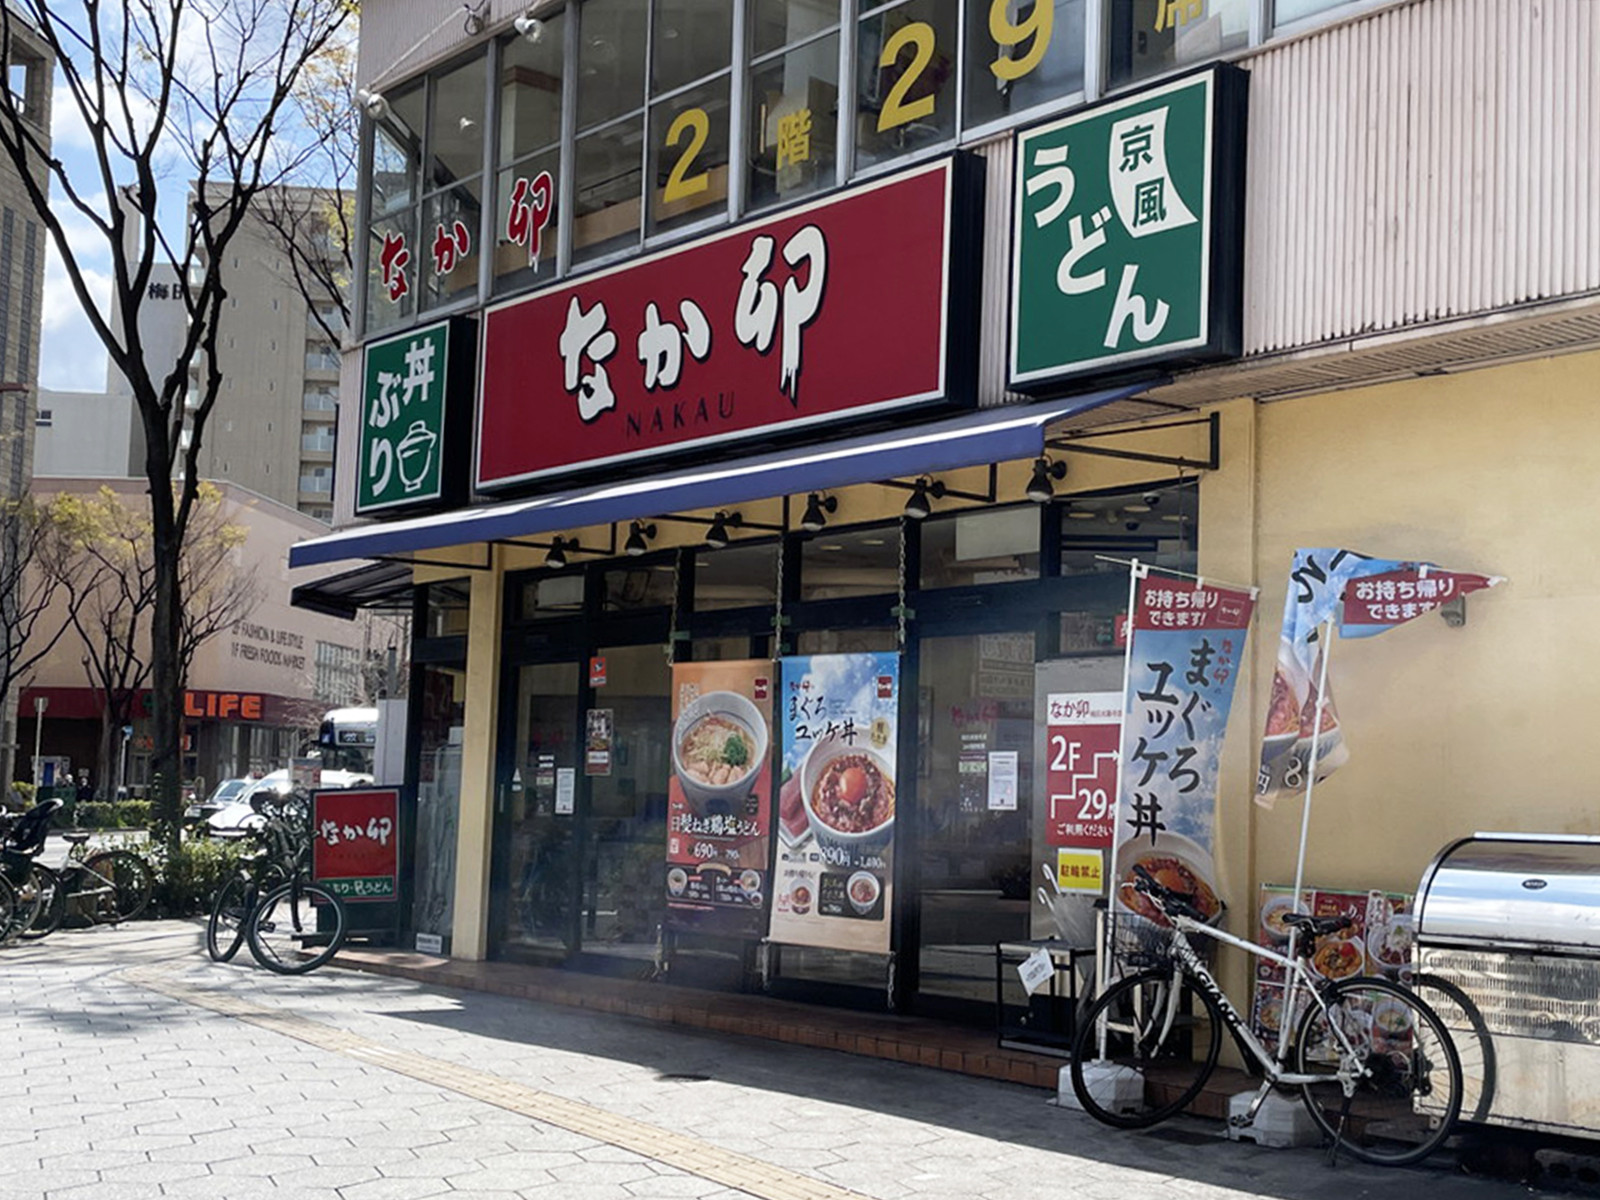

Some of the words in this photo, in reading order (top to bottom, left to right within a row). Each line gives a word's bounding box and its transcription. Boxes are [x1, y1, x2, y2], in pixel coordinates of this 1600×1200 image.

[1117, 123, 1169, 229] 京風
[379, 169, 554, 304] なか卯
[1026, 144, 1171, 349] うどん
[559, 224, 828, 421] なか卯
[369, 337, 437, 498] 丼ぶり
[625, 391, 736, 439] NAKAU
[1144, 590, 1219, 609] お持ち帰り
[1356, 577, 1455, 602] お持ち帰り
[184, 692, 262, 719] LIFE
[789, 695, 827, 722] まぐろ
[1050, 700, 1090, 719] なか卯
[1168, 638, 1216, 793] まぐろ
[795, 716, 858, 747] ユッケ丼
[1050, 735, 1082, 772] 2F
[1126, 661, 1180, 847] ユッケ丼
[320, 817, 392, 847] なか卯
